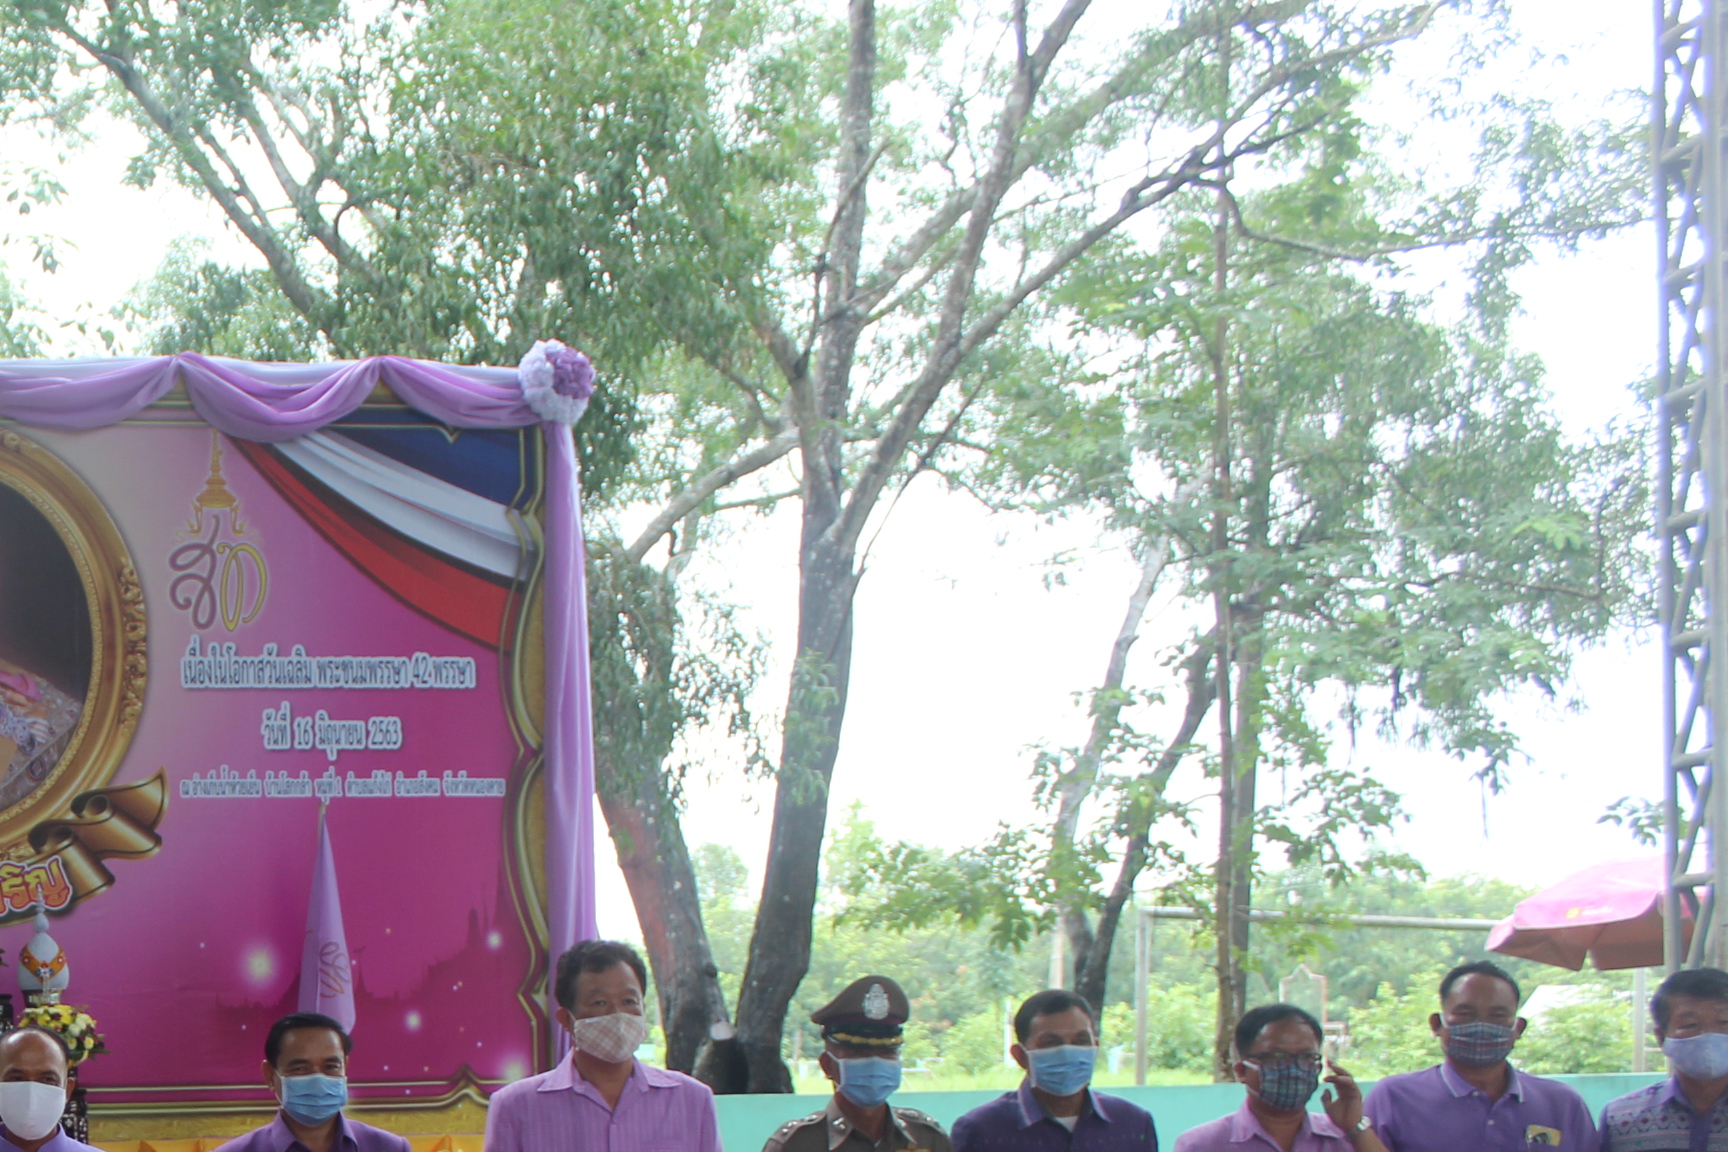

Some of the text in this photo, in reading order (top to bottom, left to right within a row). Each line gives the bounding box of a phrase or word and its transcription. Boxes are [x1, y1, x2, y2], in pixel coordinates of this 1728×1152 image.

[183, 638, 474, 685] เนื่องในโอกาสวันเฉลิม พระชนมพรรษา 42 พรรษา
[263, 703, 400, 757] วันที่ 16 มิถุนายน 2563
